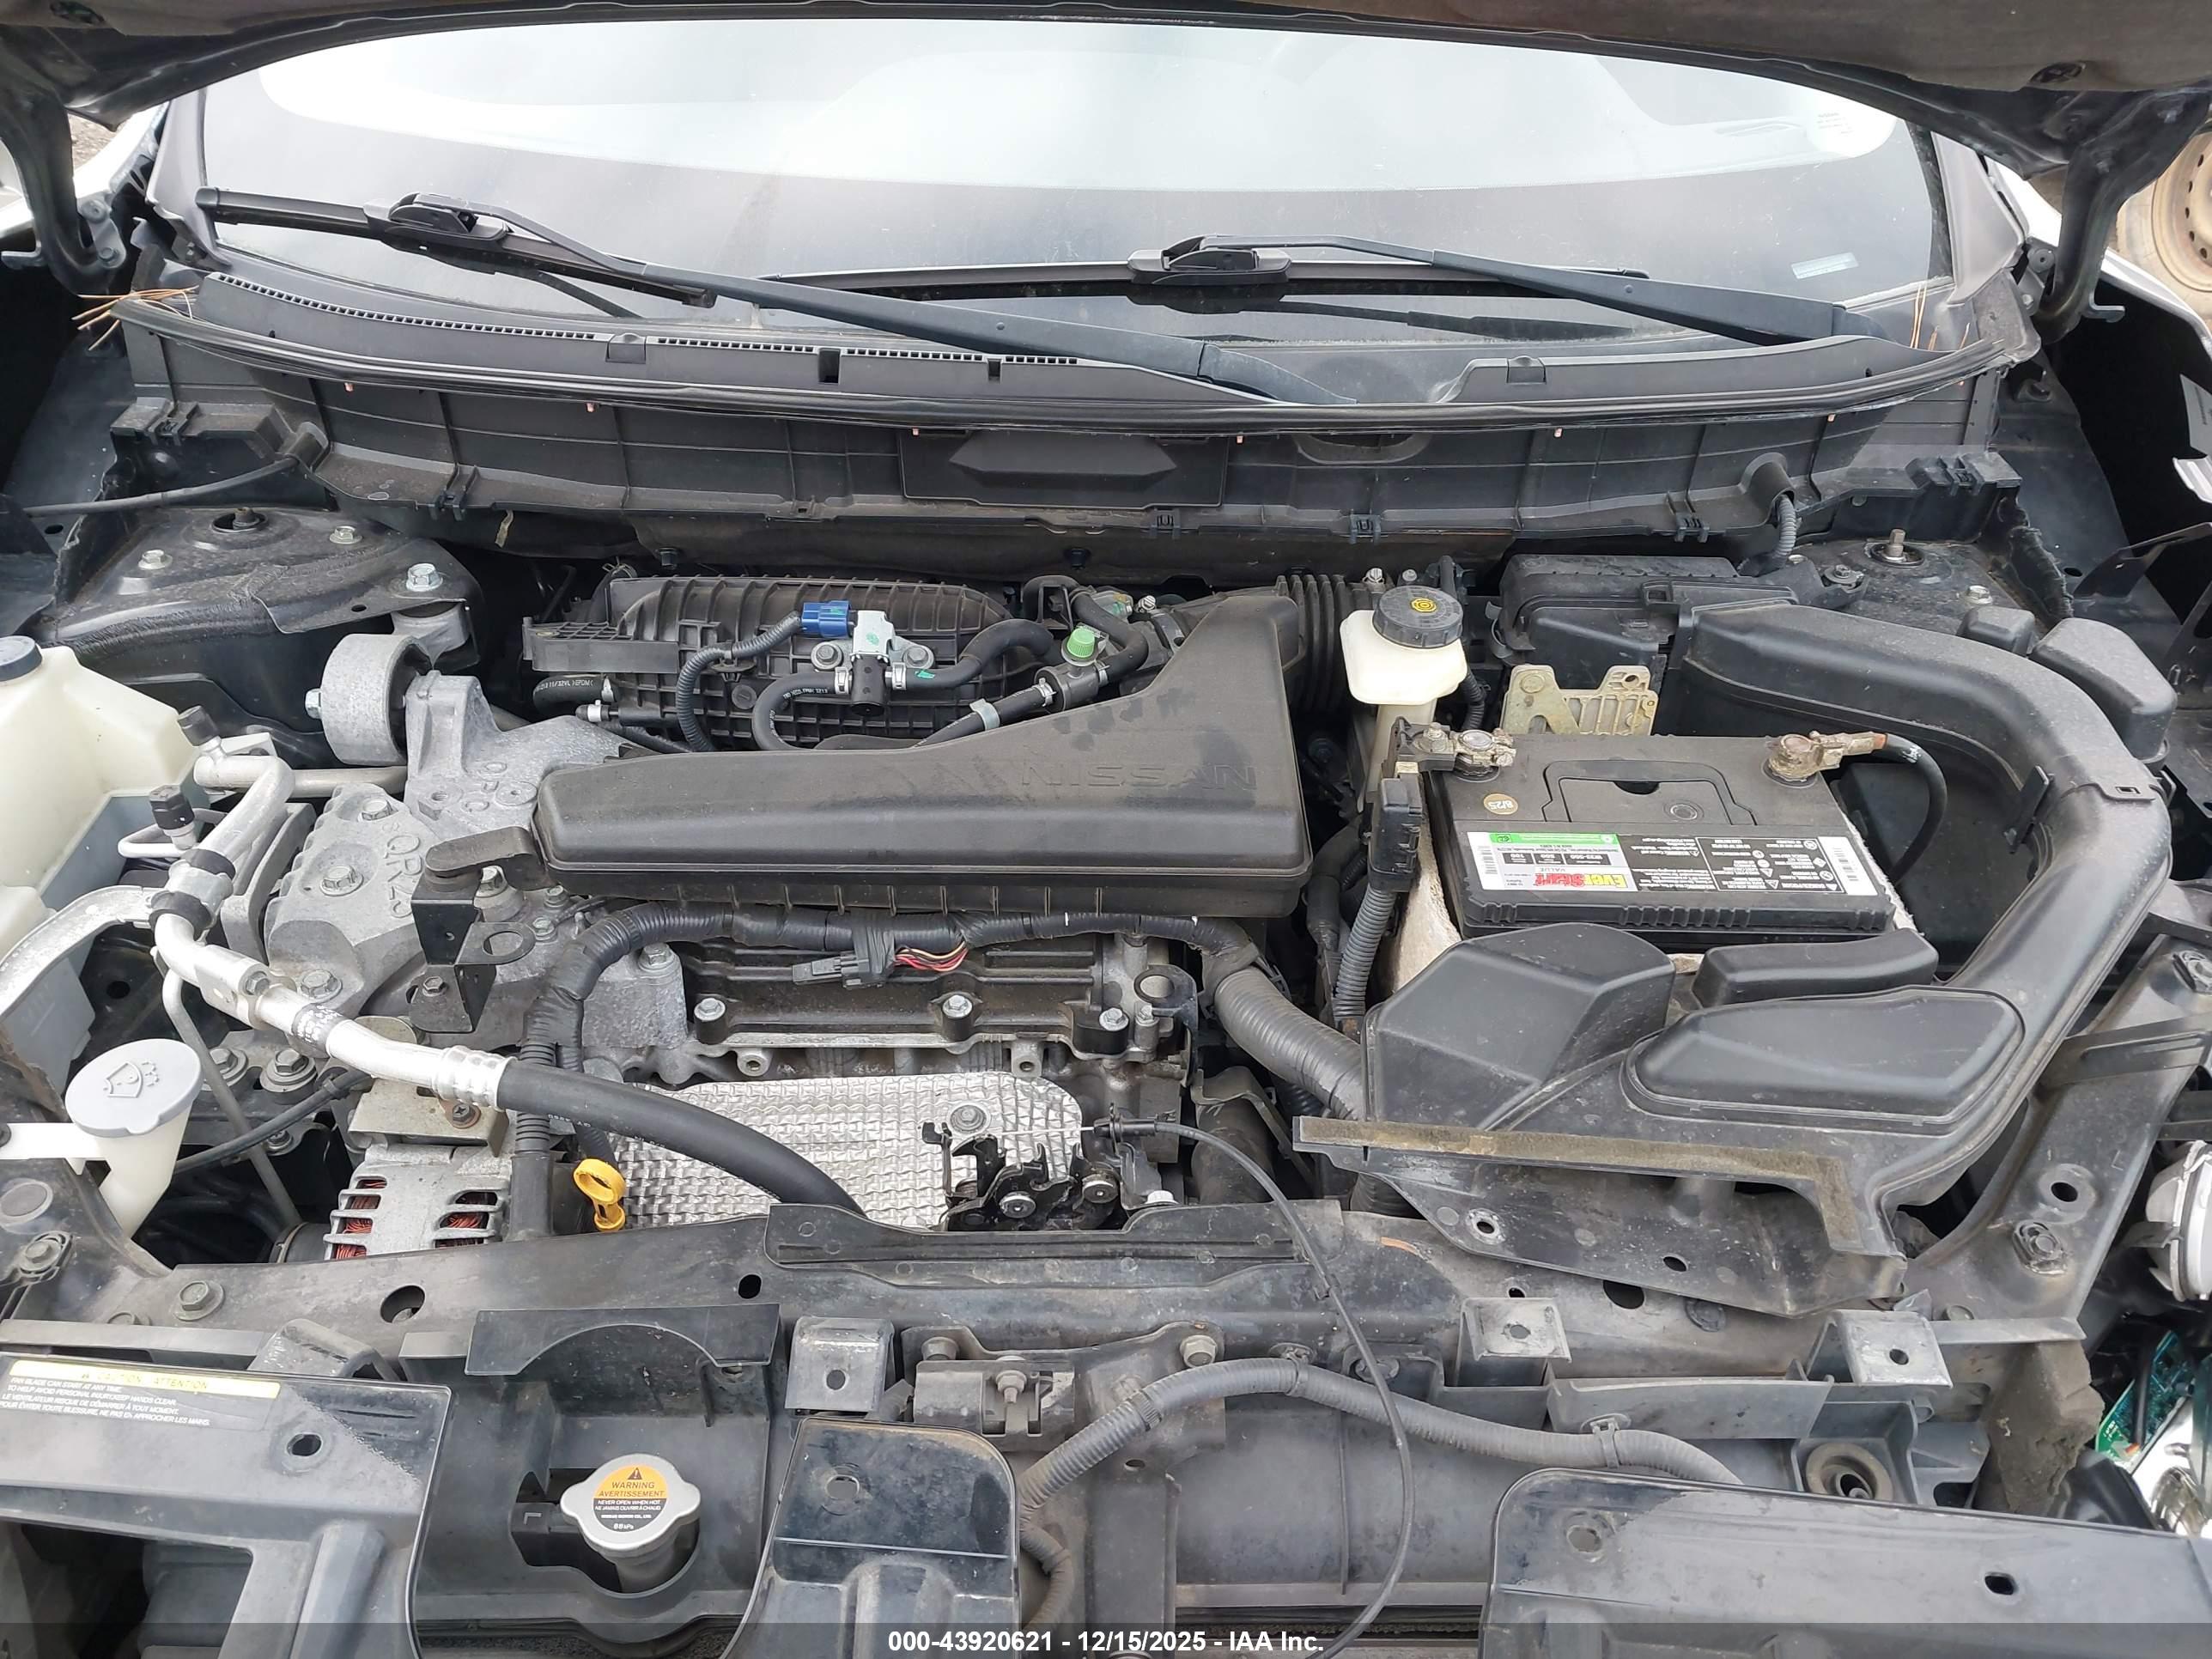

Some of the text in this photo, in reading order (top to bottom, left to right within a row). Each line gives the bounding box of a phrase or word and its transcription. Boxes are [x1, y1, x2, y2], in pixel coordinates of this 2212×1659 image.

[1022, 763, 1258, 791] NISSAN
[1534, 872, 1628, 889] EverStart
[153, 1377, 207, 1389] ATTENTION
